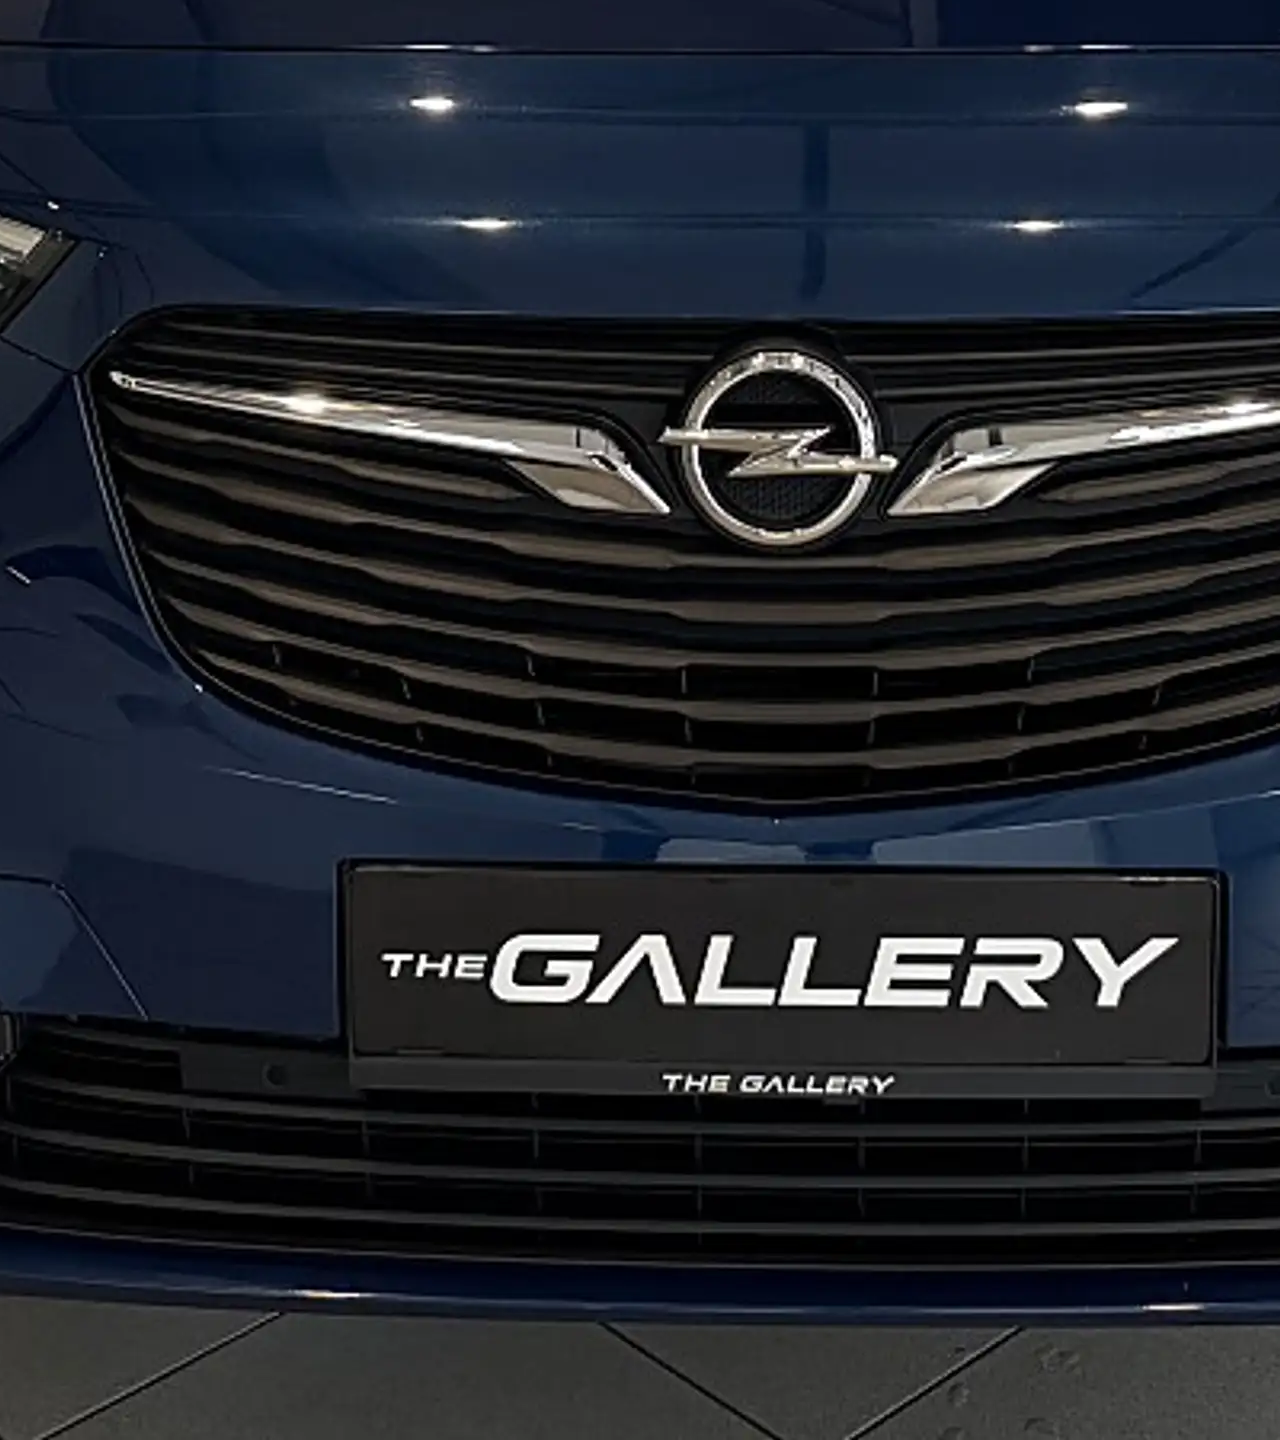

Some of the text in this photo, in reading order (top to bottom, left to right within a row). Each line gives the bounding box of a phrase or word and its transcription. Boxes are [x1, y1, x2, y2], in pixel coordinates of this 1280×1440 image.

[381, 934, 1179, 1009] THE GALLERY
[662, 1073, 895, 1095] THE GALLERY
